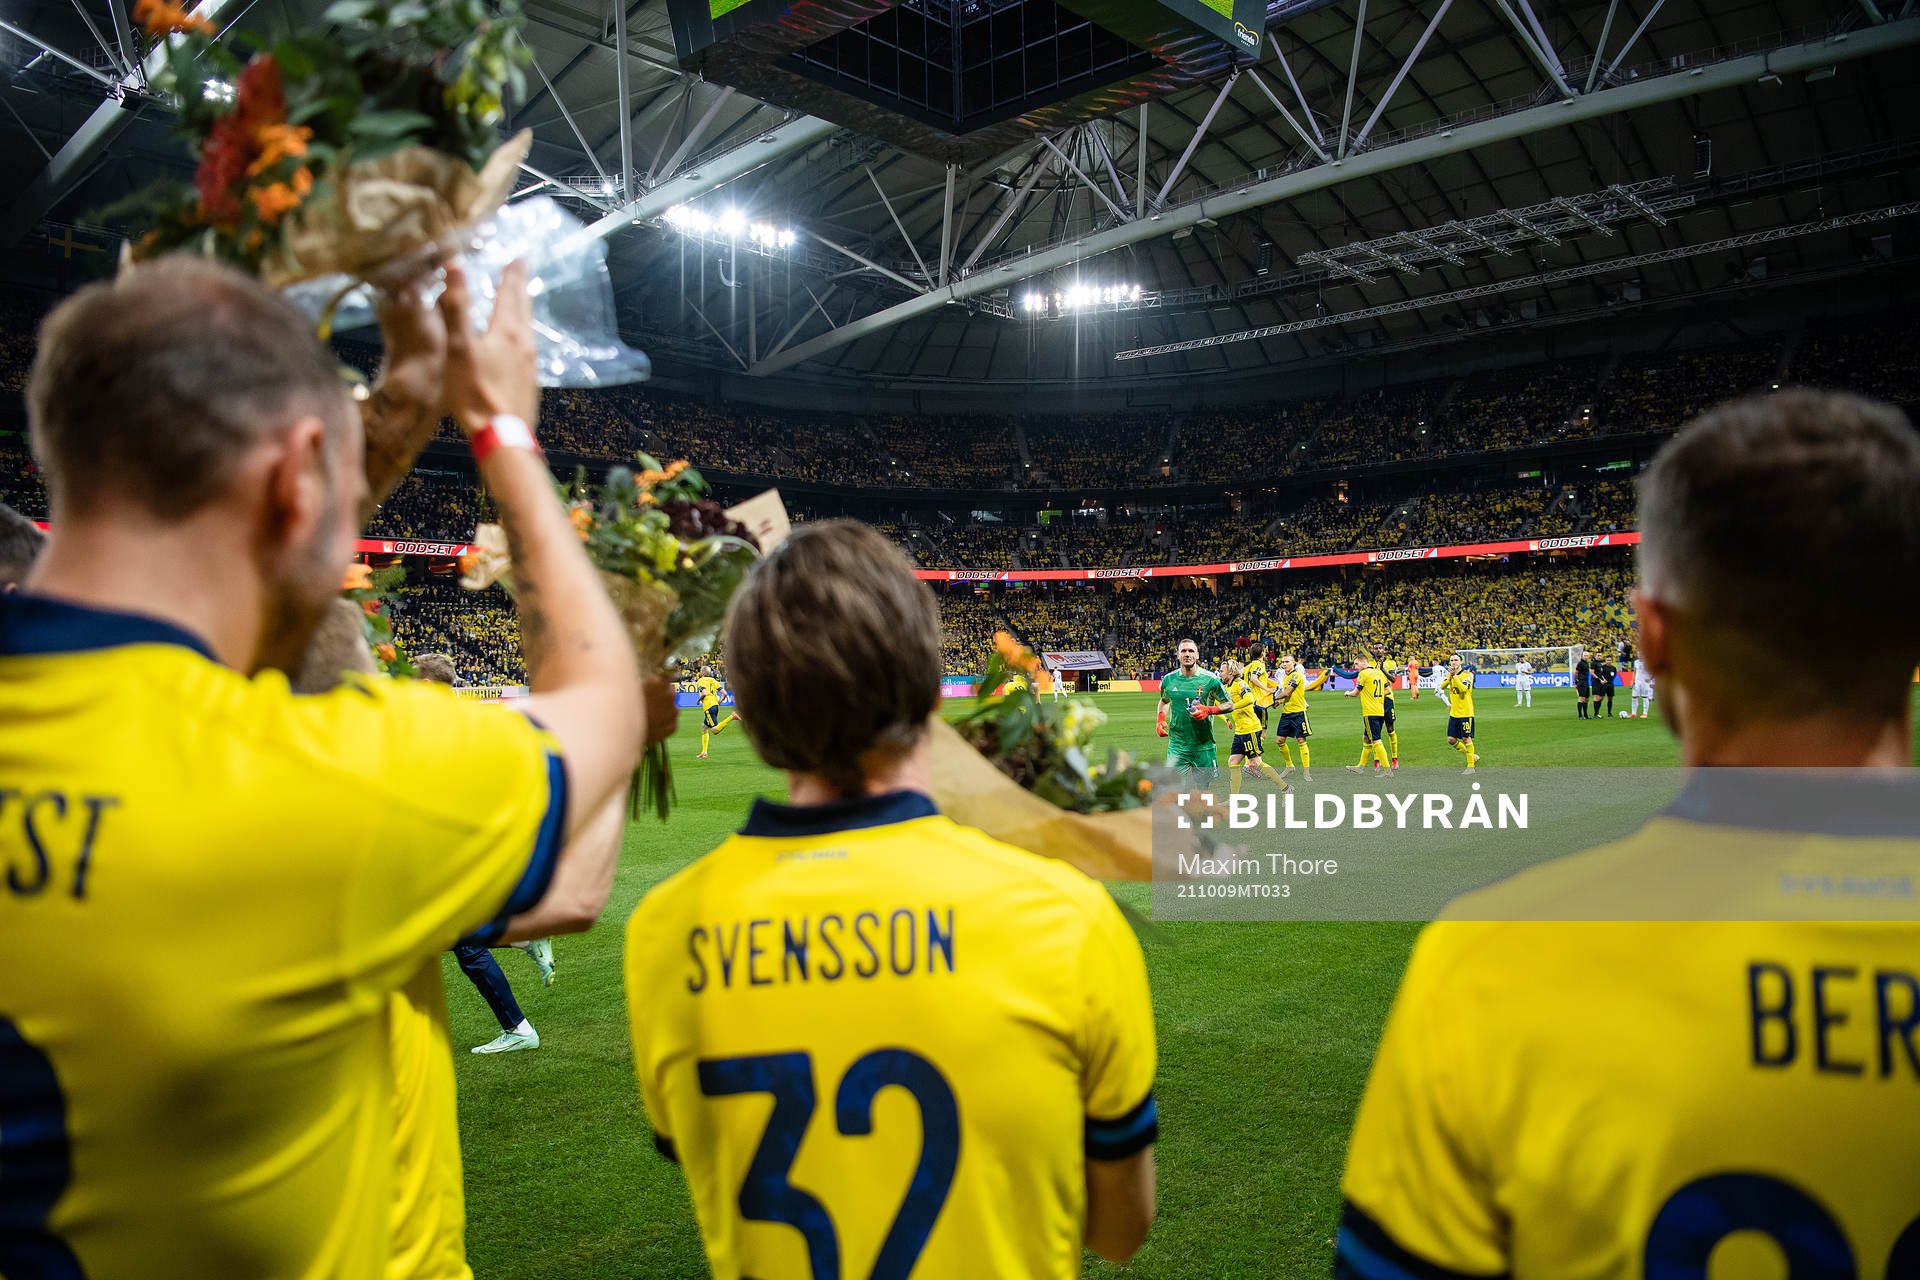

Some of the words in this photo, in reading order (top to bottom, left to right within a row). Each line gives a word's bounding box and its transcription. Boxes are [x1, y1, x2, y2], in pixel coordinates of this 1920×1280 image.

[394, 541, 457, 556] ODDSET
[1539, 535, 1598, 549] ODDSET
[1376, 549, 1428, 561] ODDSET
[1237, 559, 1282, 571] ODDSET
[957, 571, 1000, 580] ODDSET
[1096, 568, 1143, 578] ODDSET
[1373, 679, 1383, 698] 21
[1243, 740, 1254, 753] 10
[687, 909, 955, 994] SVENSSON
[1747, 960, 1920, 1084] BER
[697, 1046, 963, 1280] 32
